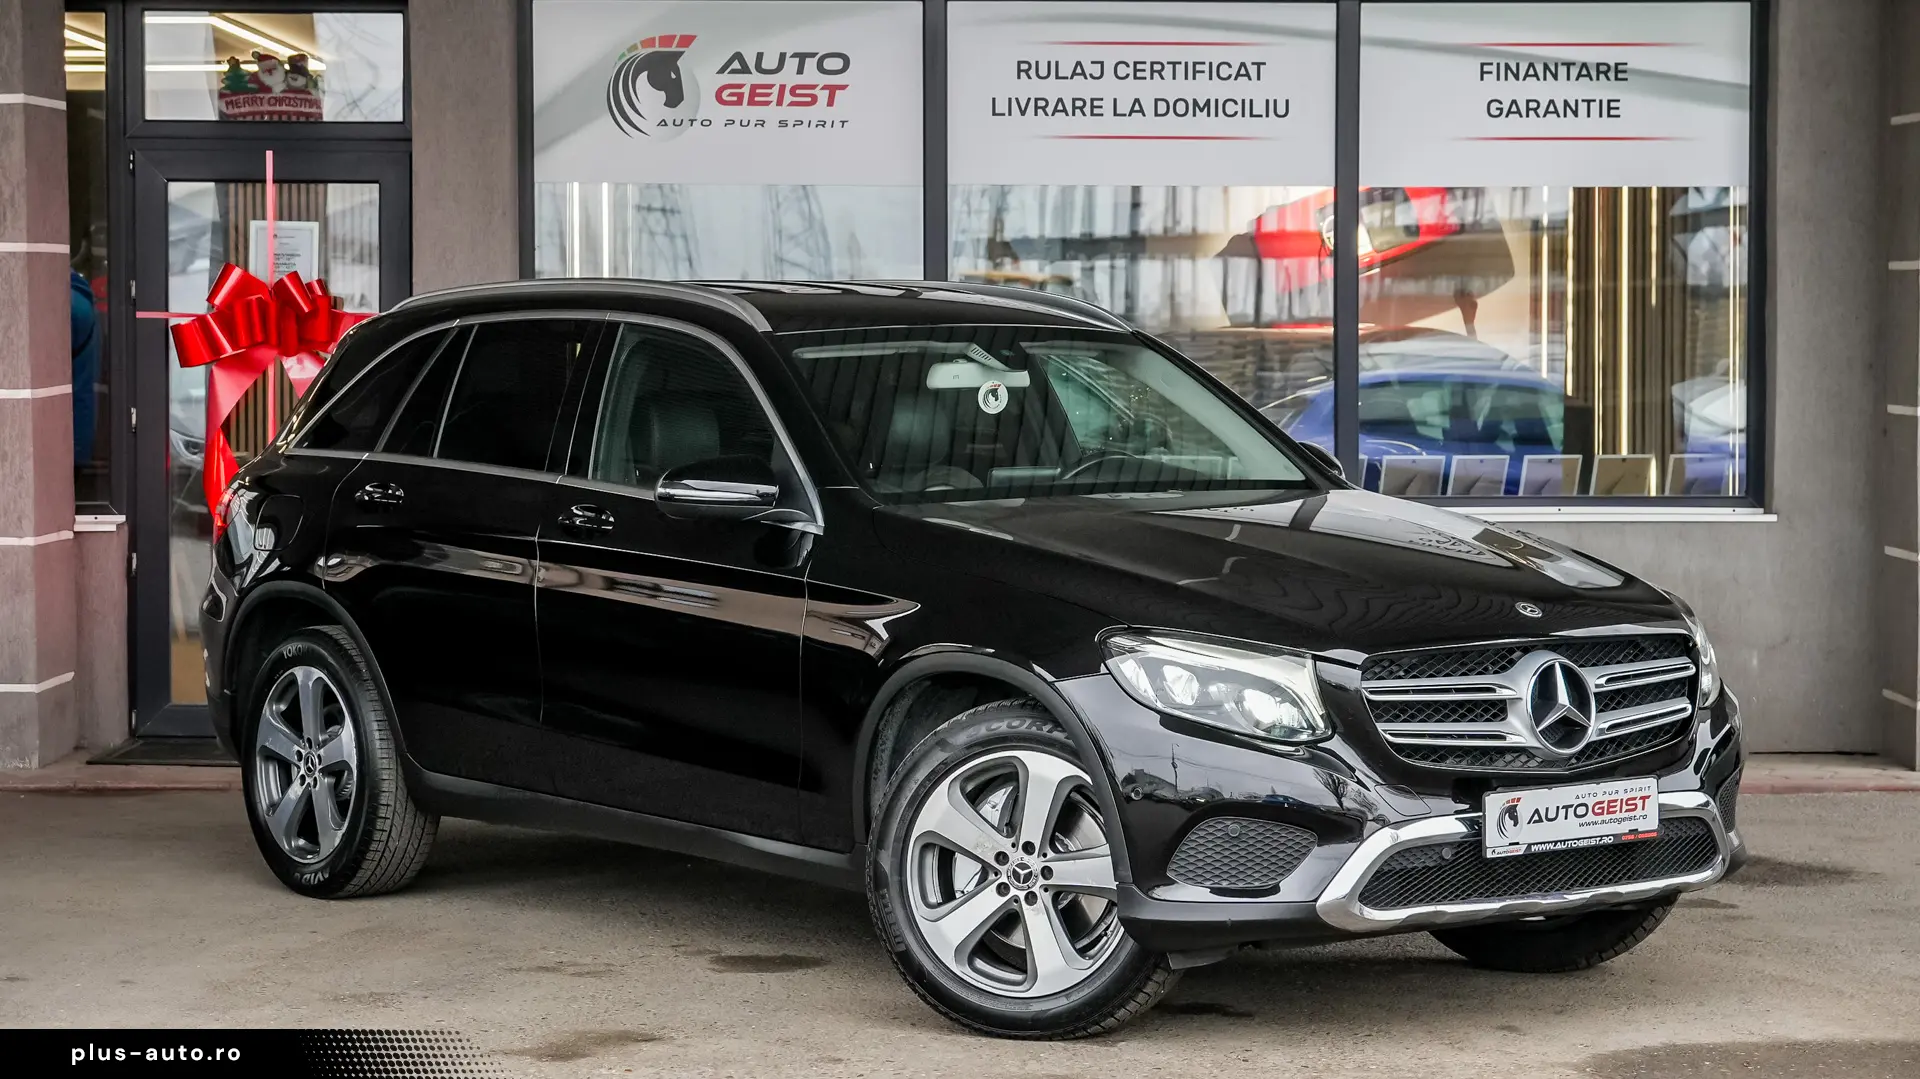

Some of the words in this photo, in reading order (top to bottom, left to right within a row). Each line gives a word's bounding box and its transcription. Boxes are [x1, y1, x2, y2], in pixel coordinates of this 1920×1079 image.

[715, 51, 851, 75] AUTO
[1016, 60, 1105, 80] RULAJ
[1113, 61, 1267, 81] CERTIFICAT
[1479, 62, 1629, 81] FINANTARE
[224, 96, 265, 110] MERRY
[714, 83, 850, 107] GEIST
[991, 97, 1104, 117] LIVRARE
[1112, 98, 1147, 117] LA
[1153, 98, 1290, 118] DOMICILIU
[1486, 98, 1621, 118] GARANTIE
[656, 118, 712, 127] AUTO
[724, 119, 766, 128] PUR
[777, 119, 849, 129] SPIRIT
[1574, 791, 1598, 800] AUTO
[1623, 785, 1652, 795] SPIRIT
[1578, 814, 1648, 828] www.autogeist.ro
[1531, 836, 1614, 852] WWW.AUTOGEIST.RO
